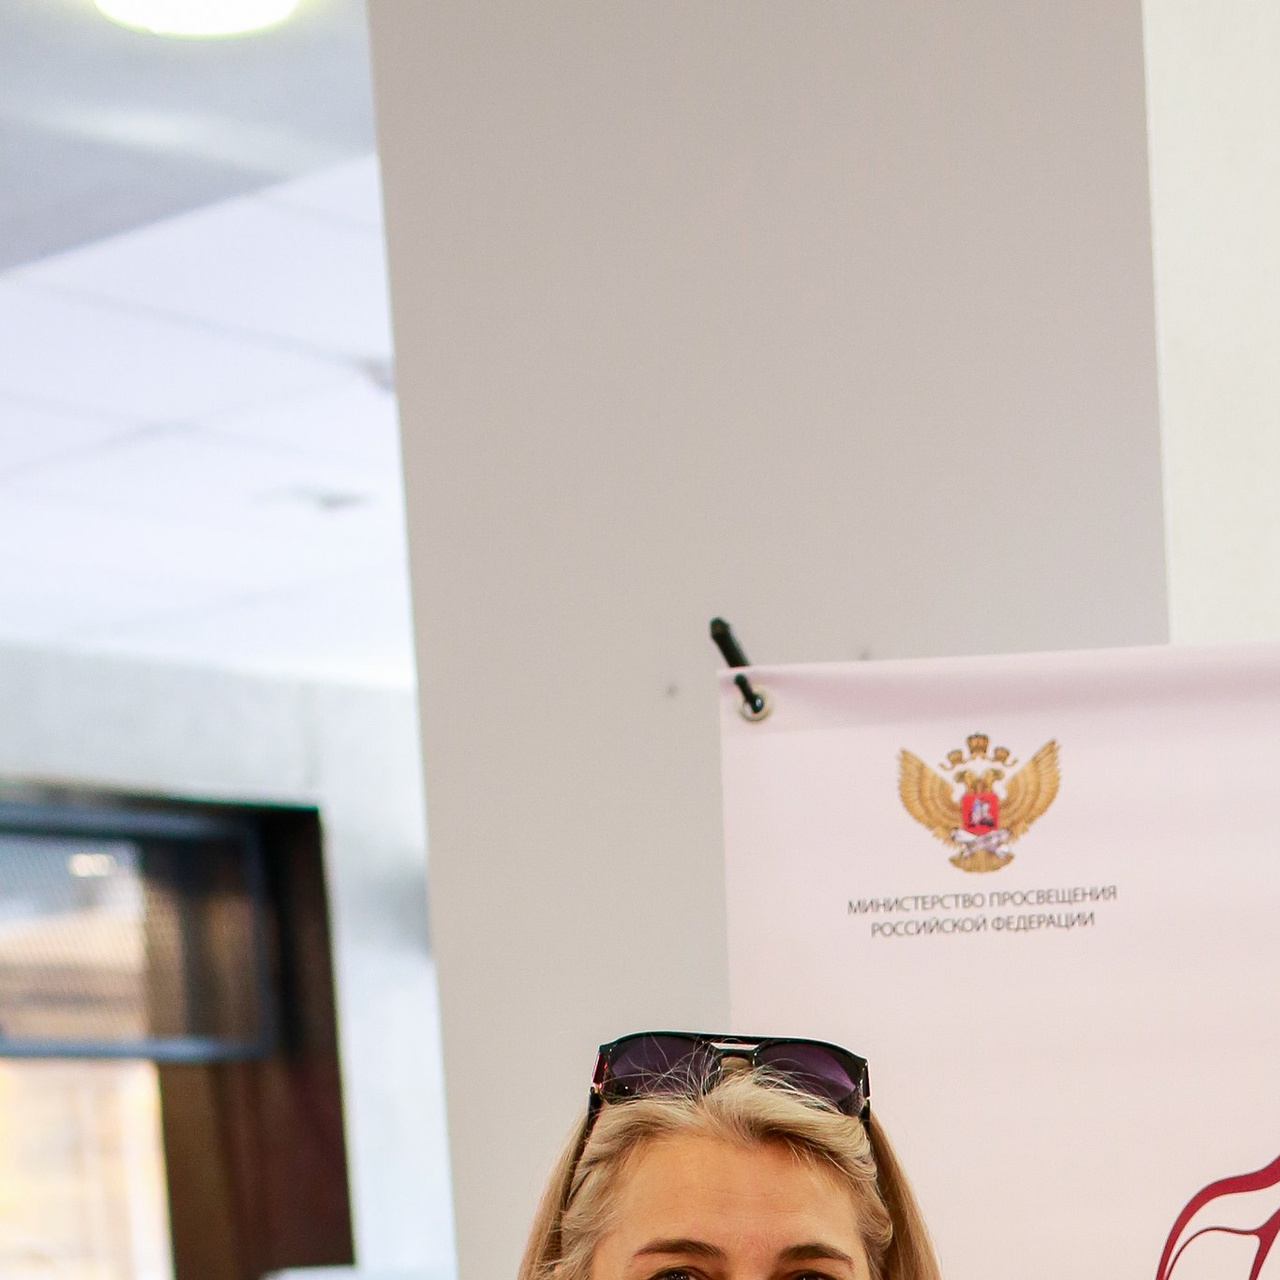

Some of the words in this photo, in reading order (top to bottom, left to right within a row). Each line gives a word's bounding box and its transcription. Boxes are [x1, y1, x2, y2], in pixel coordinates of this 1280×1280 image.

[848, 893, 983, 915] МИНИСТЕРСТВО
[989, 885, 1117, 907] ПРОСВЕЩЕНИЯ
[871, 916, 987, 938] РОССИЙСКОЙ
[991, 912, 1095, 932] ФЕДЕРАЦИИ
